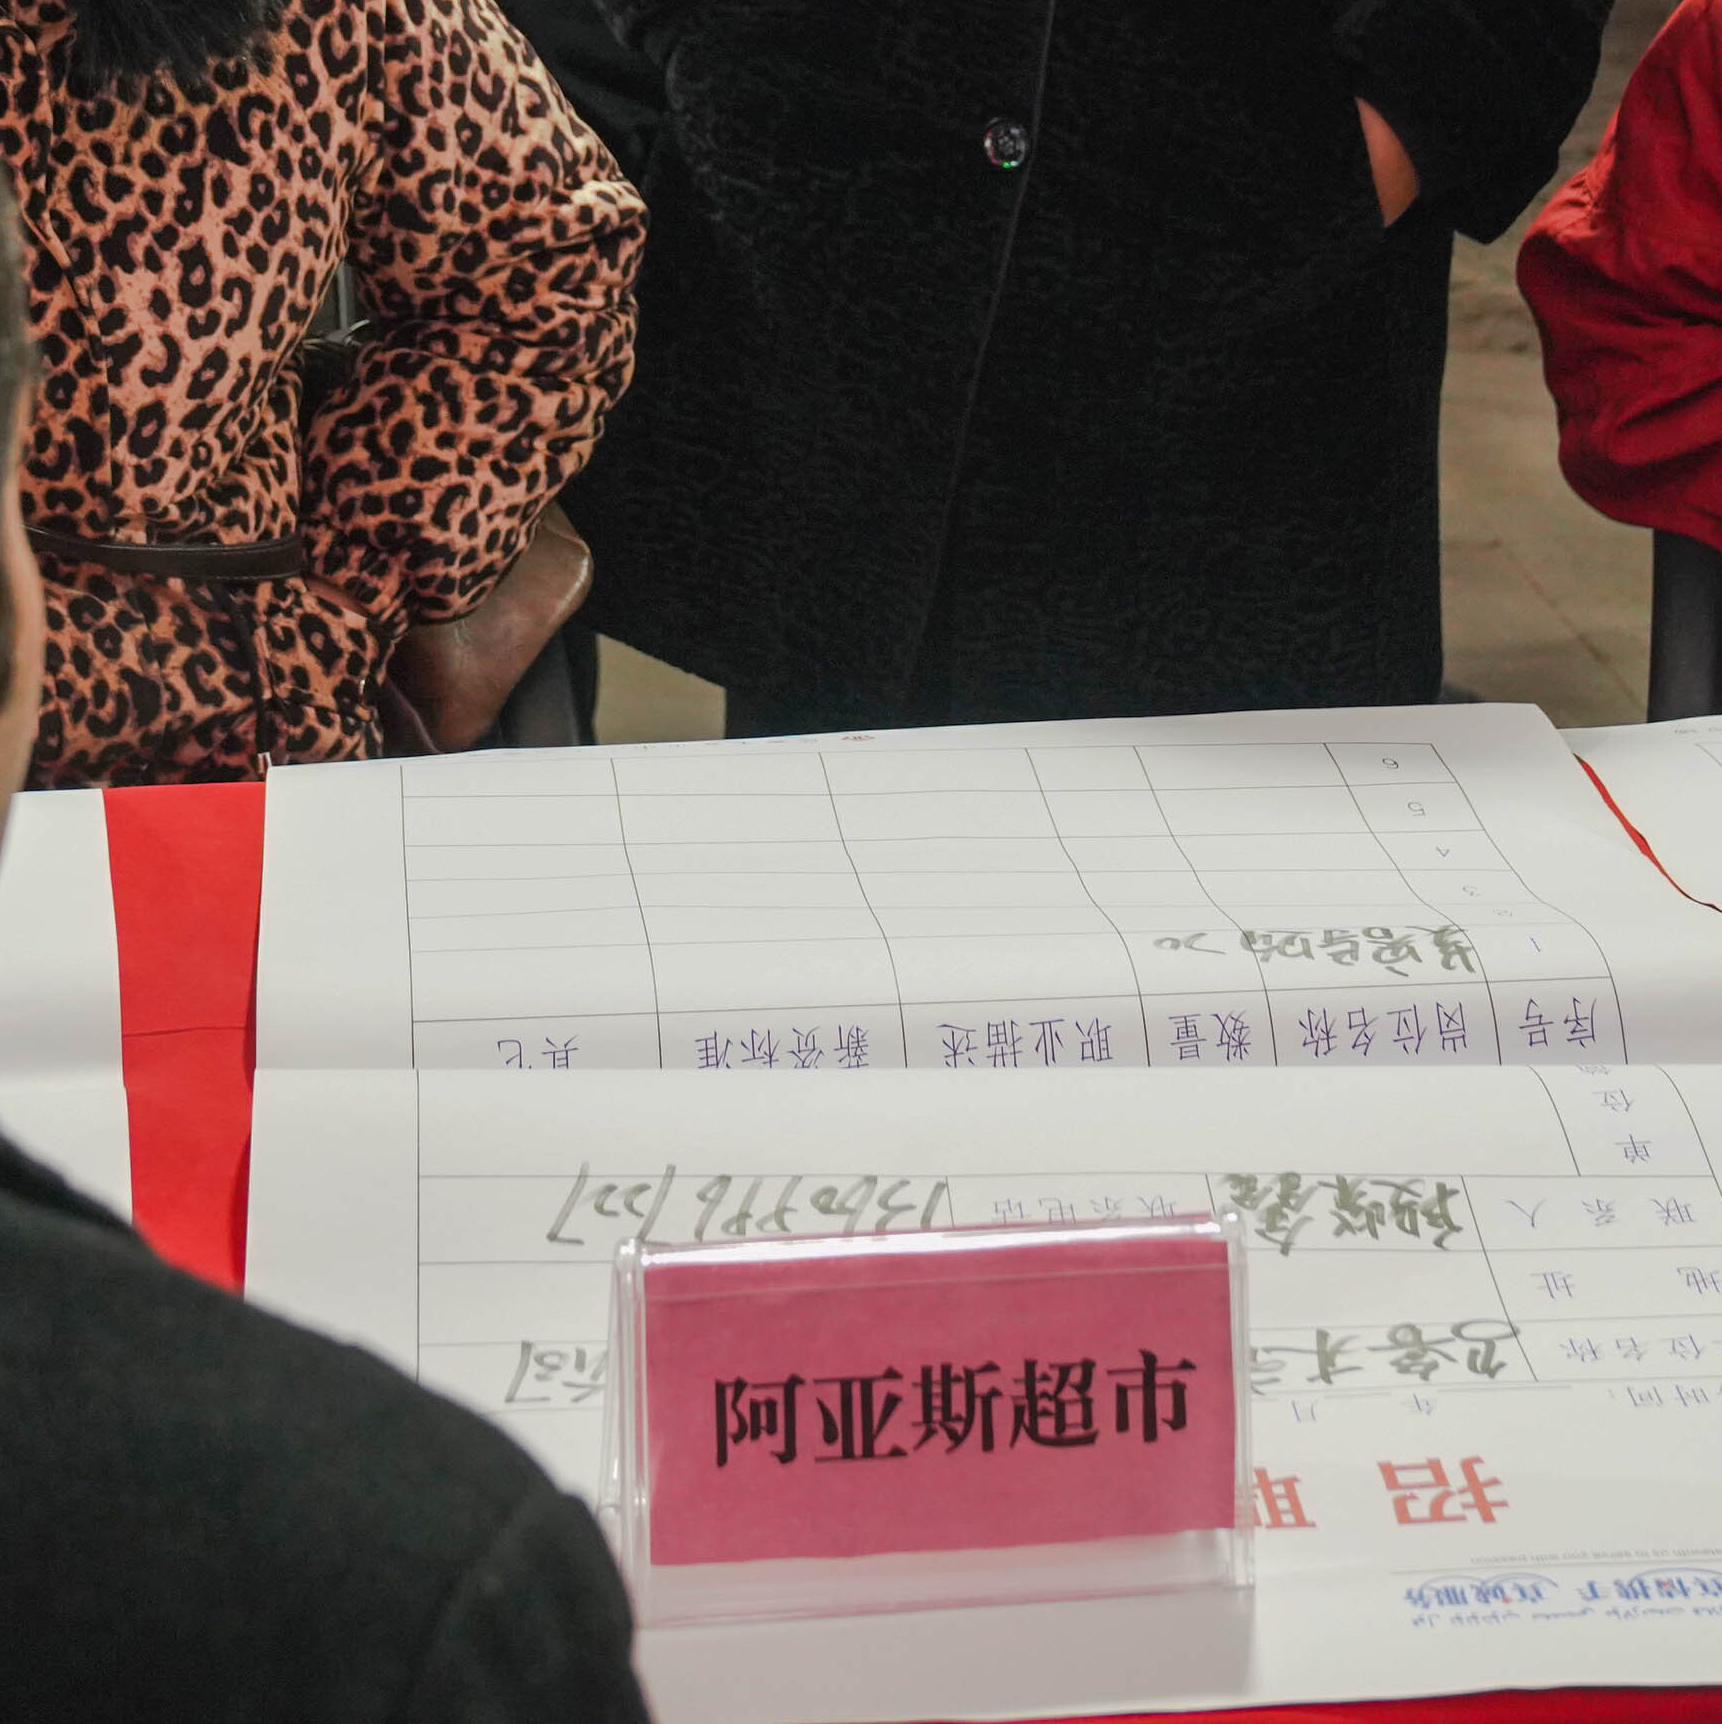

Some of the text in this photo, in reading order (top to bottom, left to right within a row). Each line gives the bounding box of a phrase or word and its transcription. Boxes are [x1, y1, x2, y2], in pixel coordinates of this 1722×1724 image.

[693, 1024, 871, 1069] 薪资标准
[934, 1018, 1113, 1068] 职业描述
[1166, 1010, 1252, 1061] 数量
[1297, 1003, 1468, 1059] 岗位名称
[1516, 997, 1598, 1050] 序号
[1504, 1198, 1694, 1229] 联系人
[714, 1347, 1197, 1468] 阿亚斯超市
